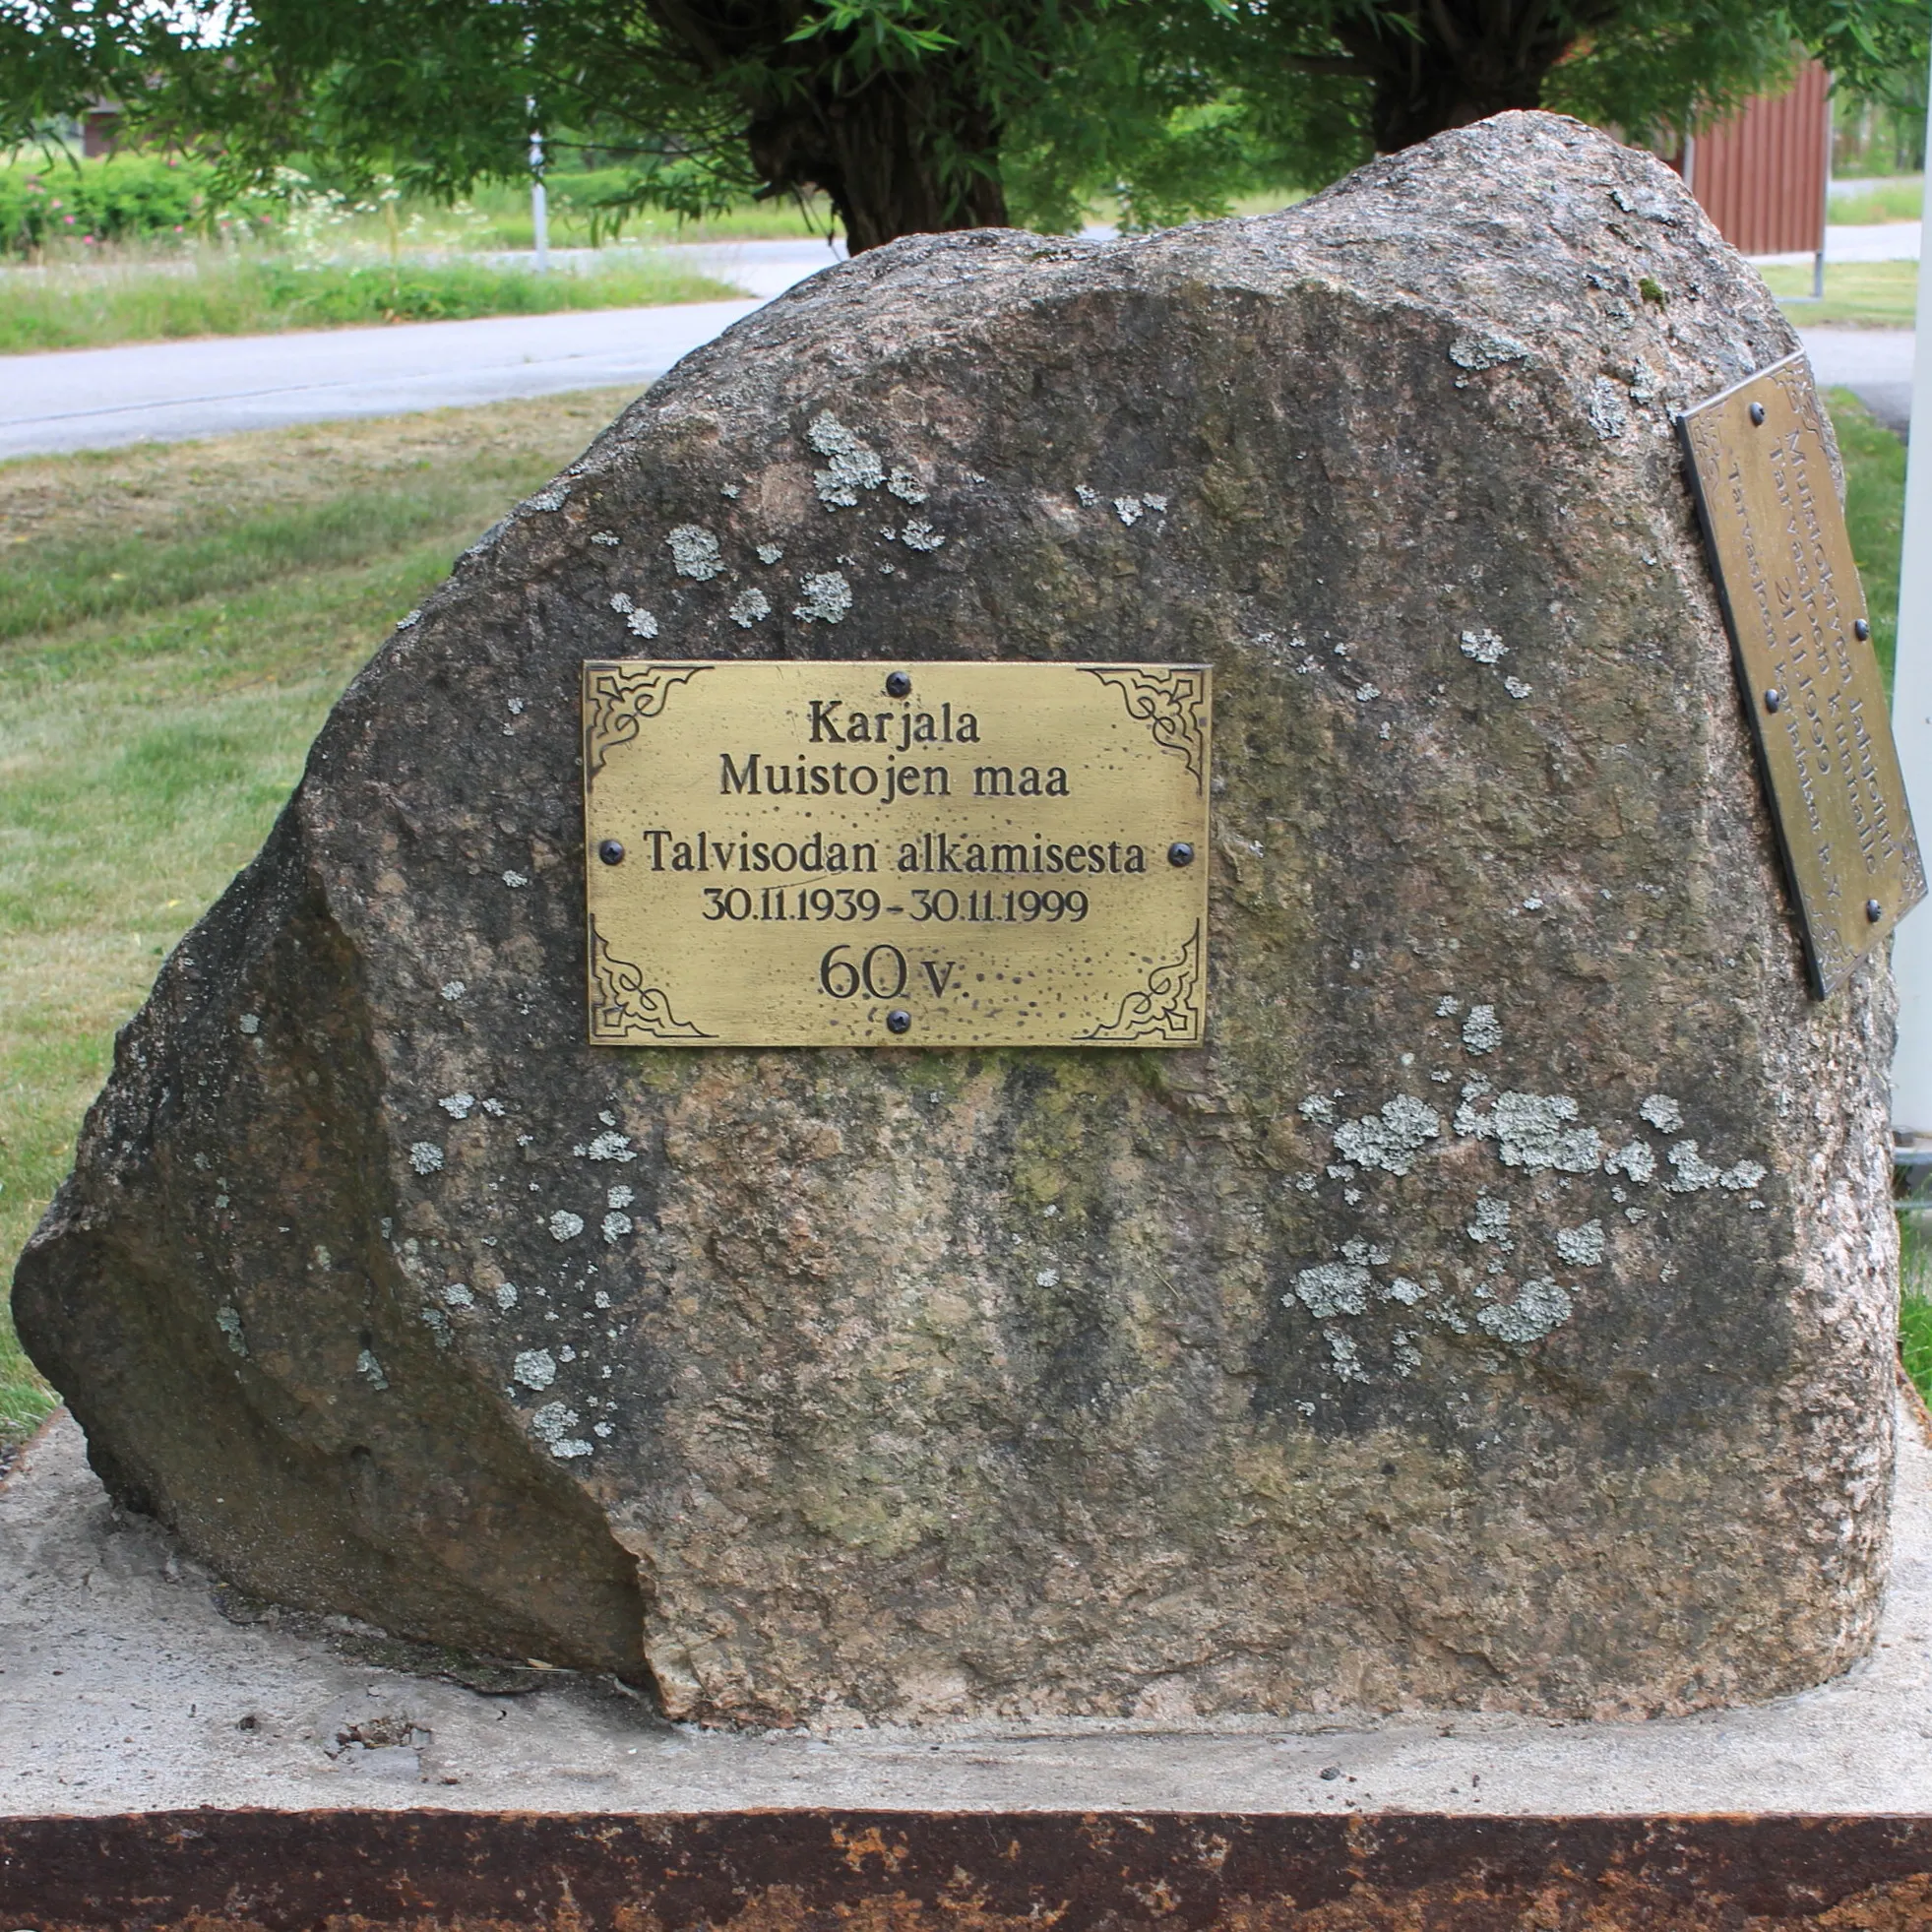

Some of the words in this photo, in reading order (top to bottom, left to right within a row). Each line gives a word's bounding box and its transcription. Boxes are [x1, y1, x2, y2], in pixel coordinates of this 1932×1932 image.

[1727, 463, 1778, 651] Tarvasjoen
[1769, 436, 1832, 676] Tarvasjoen
[1826, 689, 1876, 878] kunnalle
[1775, 574, 1833, 779] 21.11.1999
[1784, 427, 1853, 686] Muistokiven
[1848, 697, 1896, 861] lahjoitti
[719, 753, 953, 804] Muistojen
[972, 766, 1071, 797] maa
[809, 700, 981, 752] Karjala
[642, 830, 880, 874] Talvisodan
[896, 831, 1148, 875] alkamisesta
[819, 943, 910, 1000] 60
